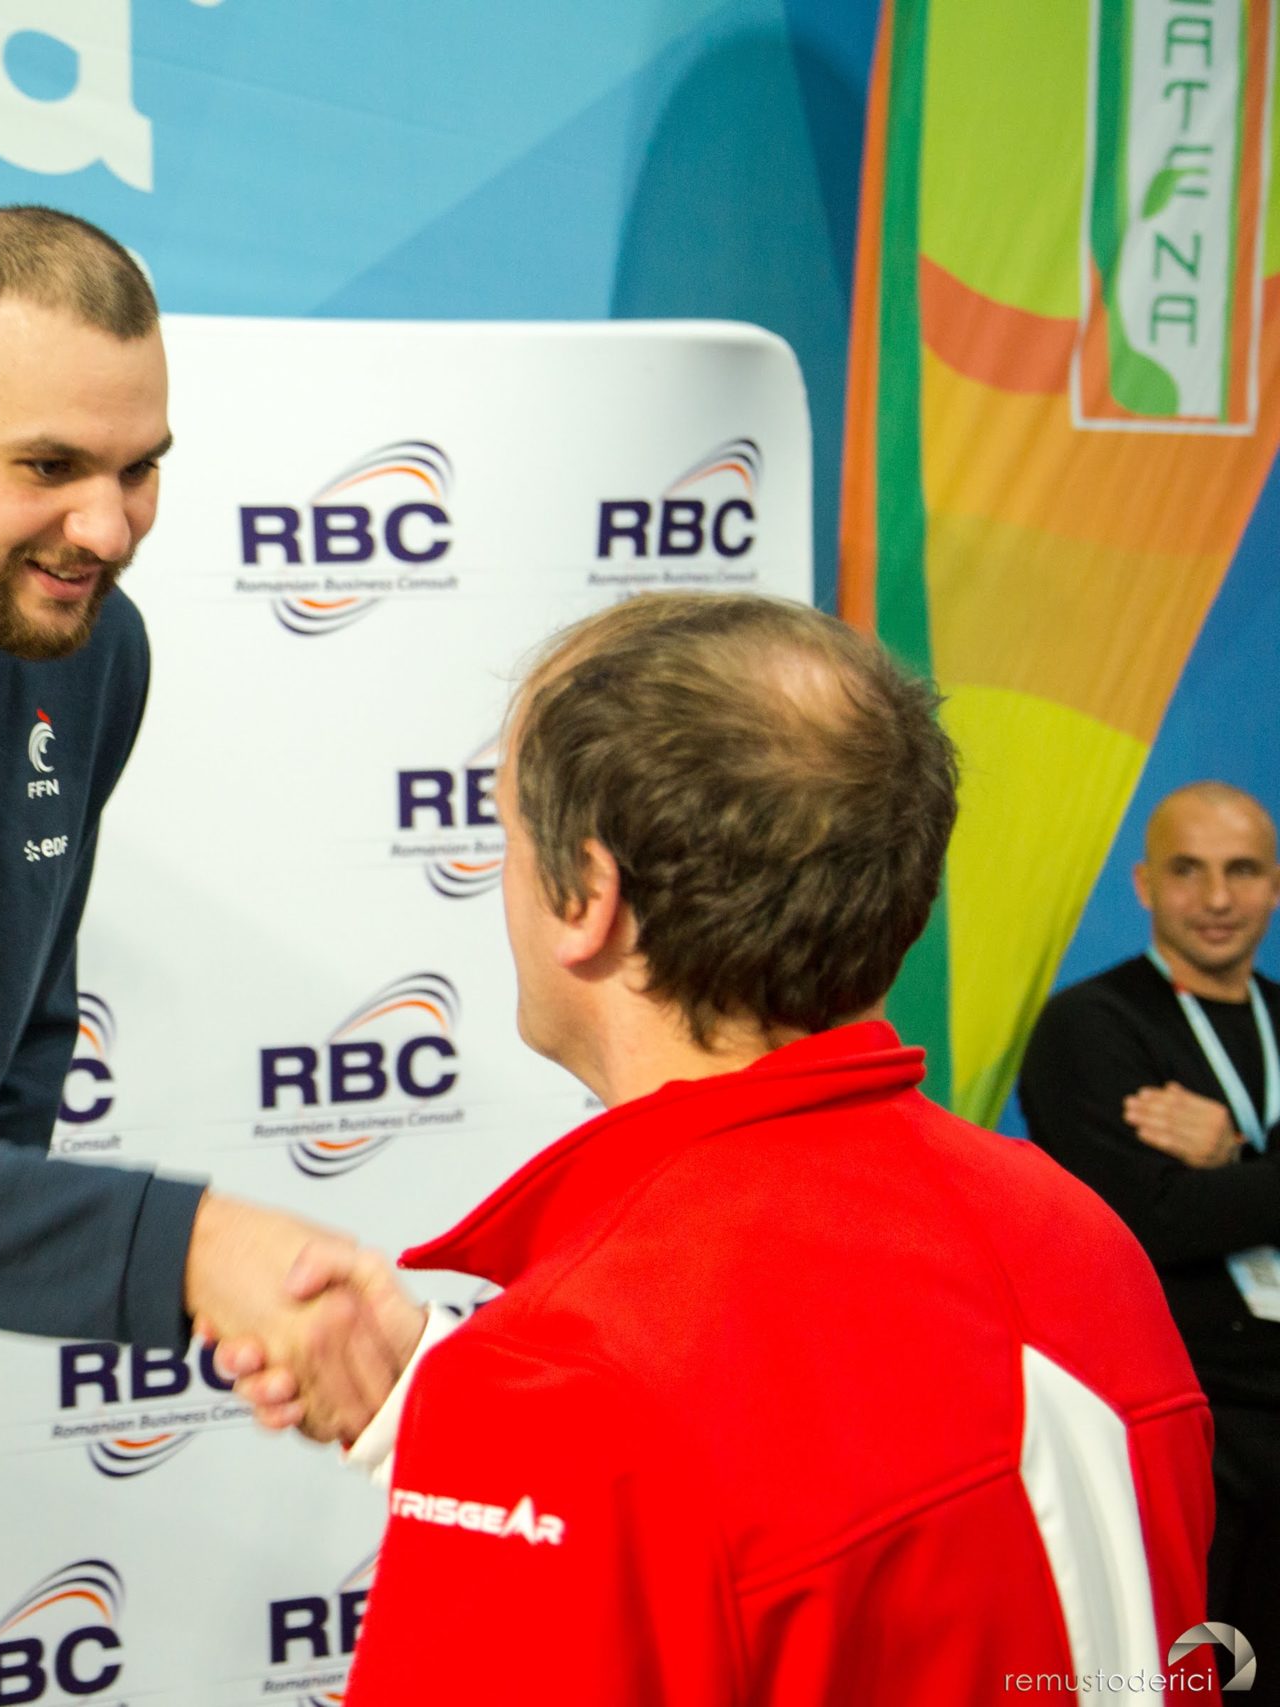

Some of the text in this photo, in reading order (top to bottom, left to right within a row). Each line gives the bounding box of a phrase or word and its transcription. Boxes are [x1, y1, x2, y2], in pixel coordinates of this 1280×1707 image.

[1148, 0, 1214, 347] ATENA
[239, 502, 452, 565] RBC
[597, 498, 756, 558] RBC
[27, 779, 61, 799] FFN
[397, 768, 500, 829] RB
[260, 1035, 459, 1109] RBC
[253, 1108, 465, 1139] Romanian Business Consult
[52, 1404, 253, 1439] Romanian Business Cons
